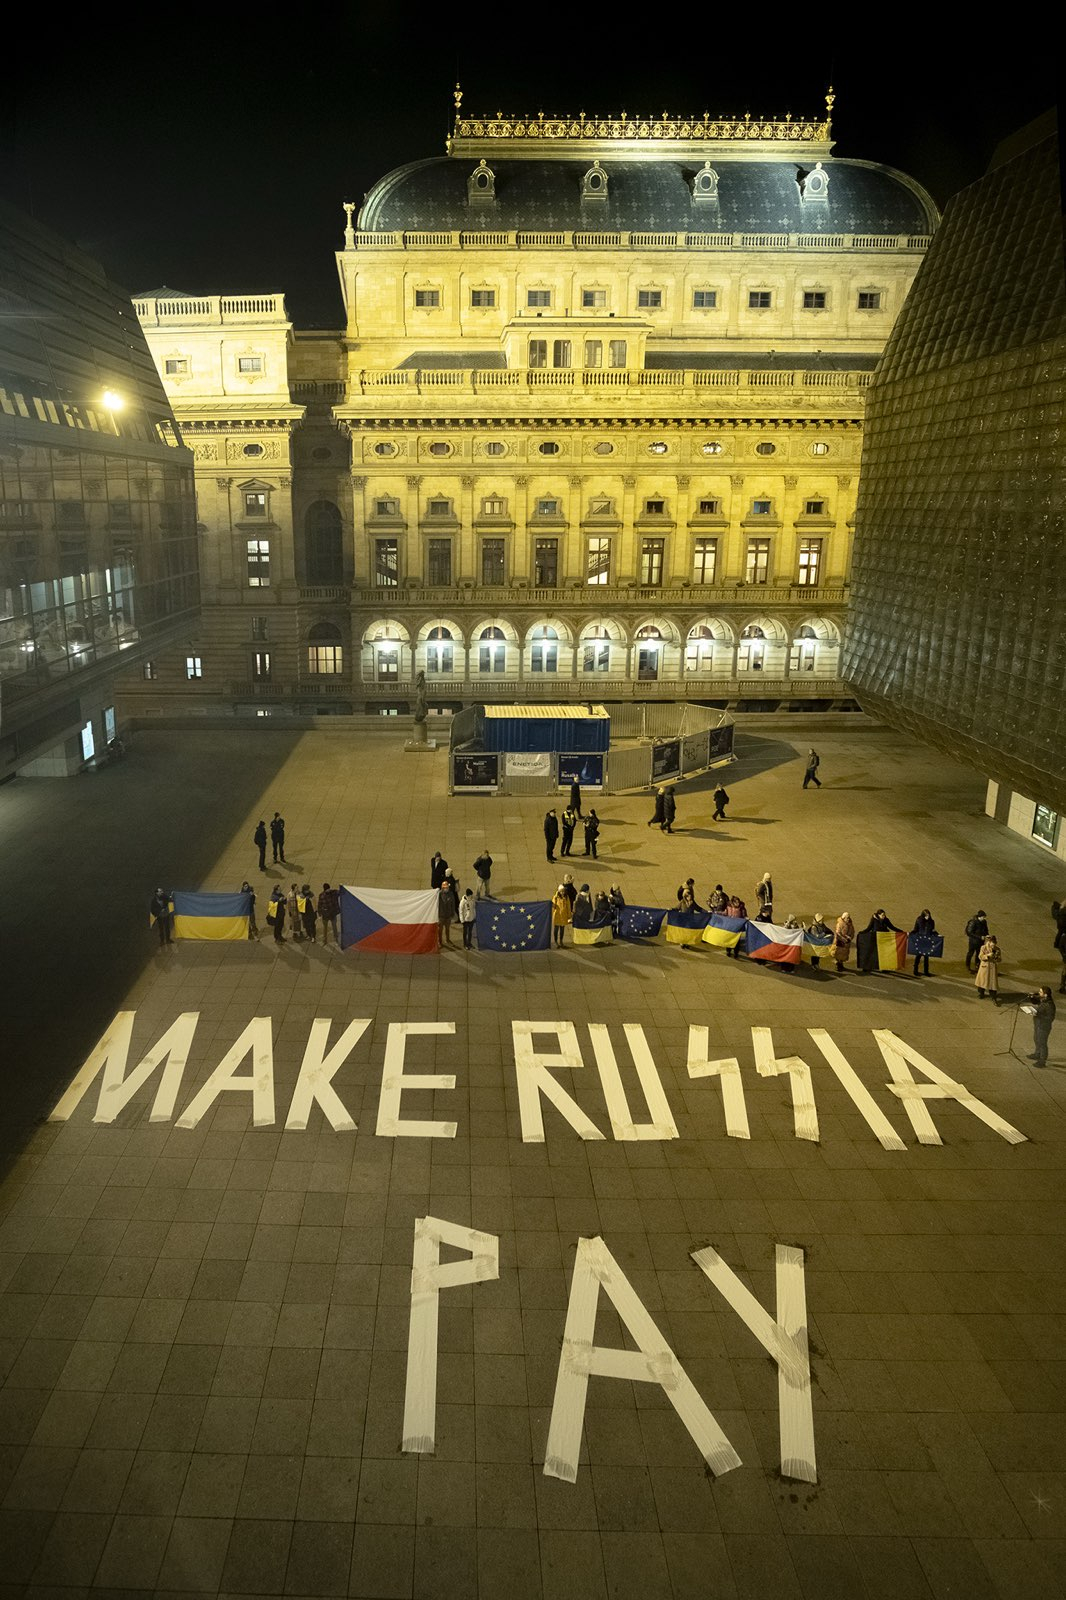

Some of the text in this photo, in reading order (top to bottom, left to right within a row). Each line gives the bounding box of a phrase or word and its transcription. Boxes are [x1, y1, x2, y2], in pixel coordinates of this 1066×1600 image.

[48, 1010, 1029, 1152] MAKE RUSSIA
[401, 1216, 820, 1484] PAY
